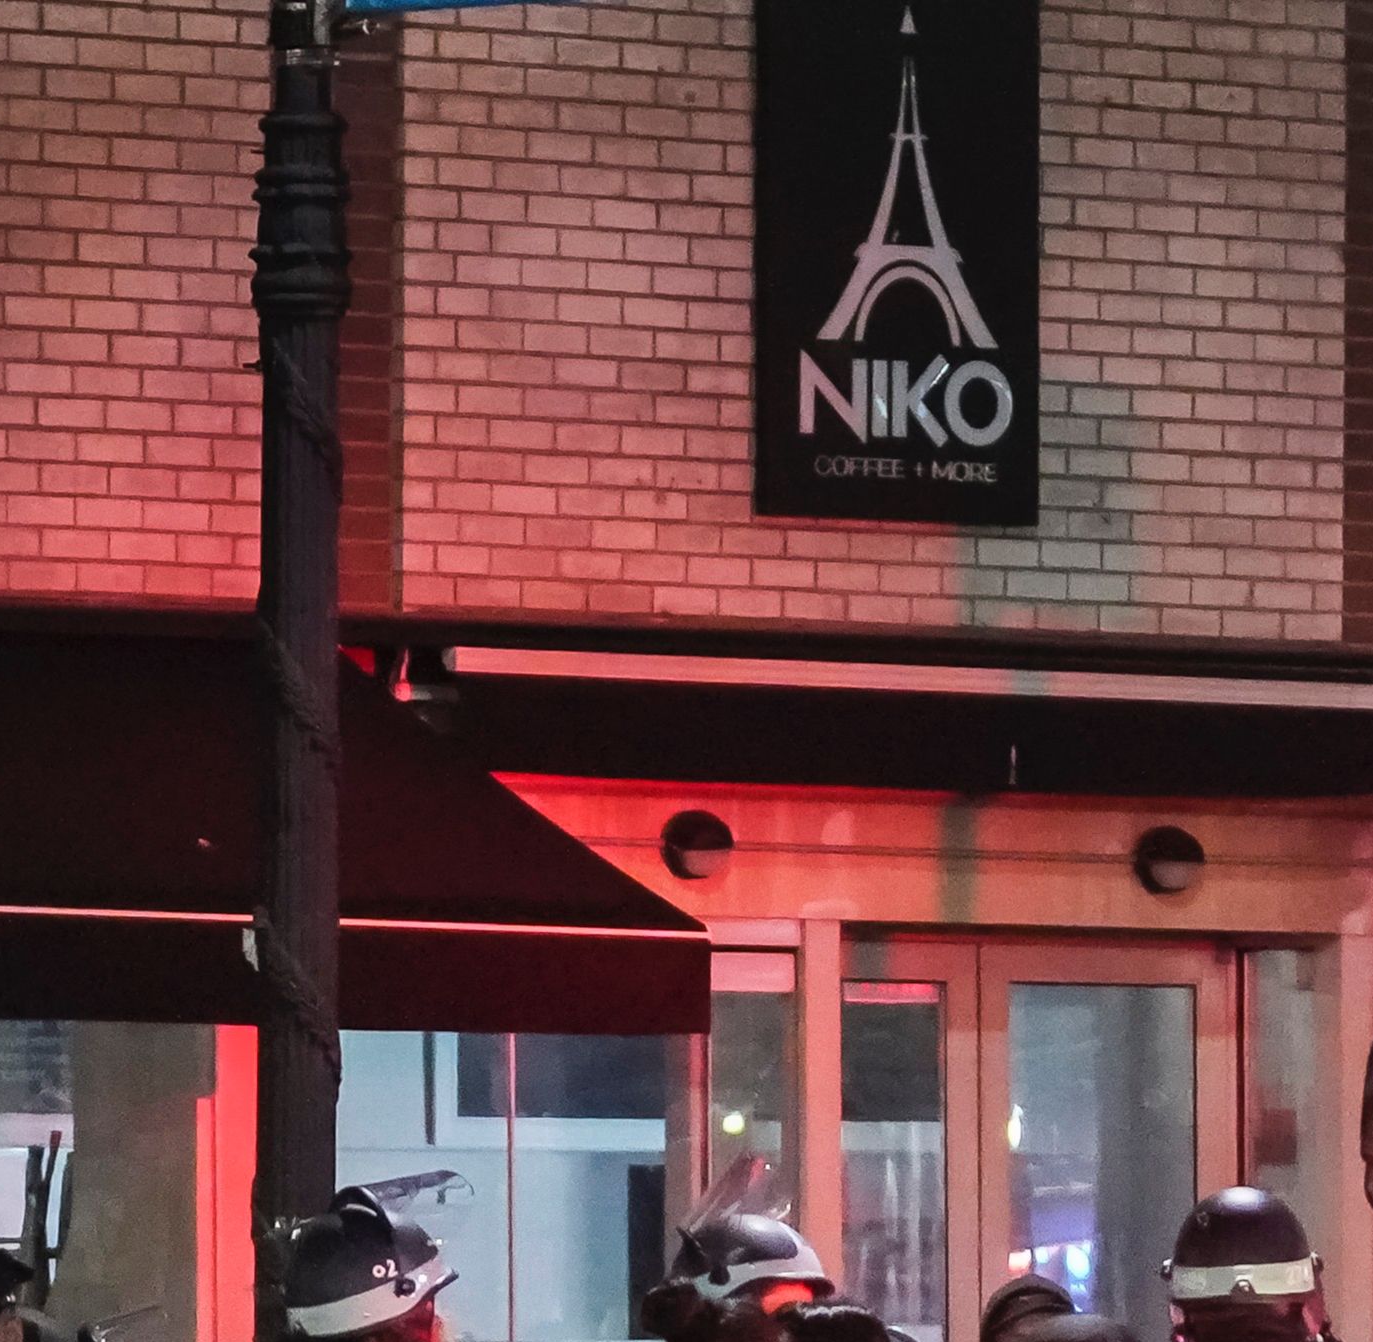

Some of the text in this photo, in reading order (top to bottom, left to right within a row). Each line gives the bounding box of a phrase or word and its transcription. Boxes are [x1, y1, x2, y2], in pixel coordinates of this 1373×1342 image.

[799, 349, 1013, 447] NIKO
[814, 455, 906, 479] COFFEE
[931, 460, 998, 482] MORE
